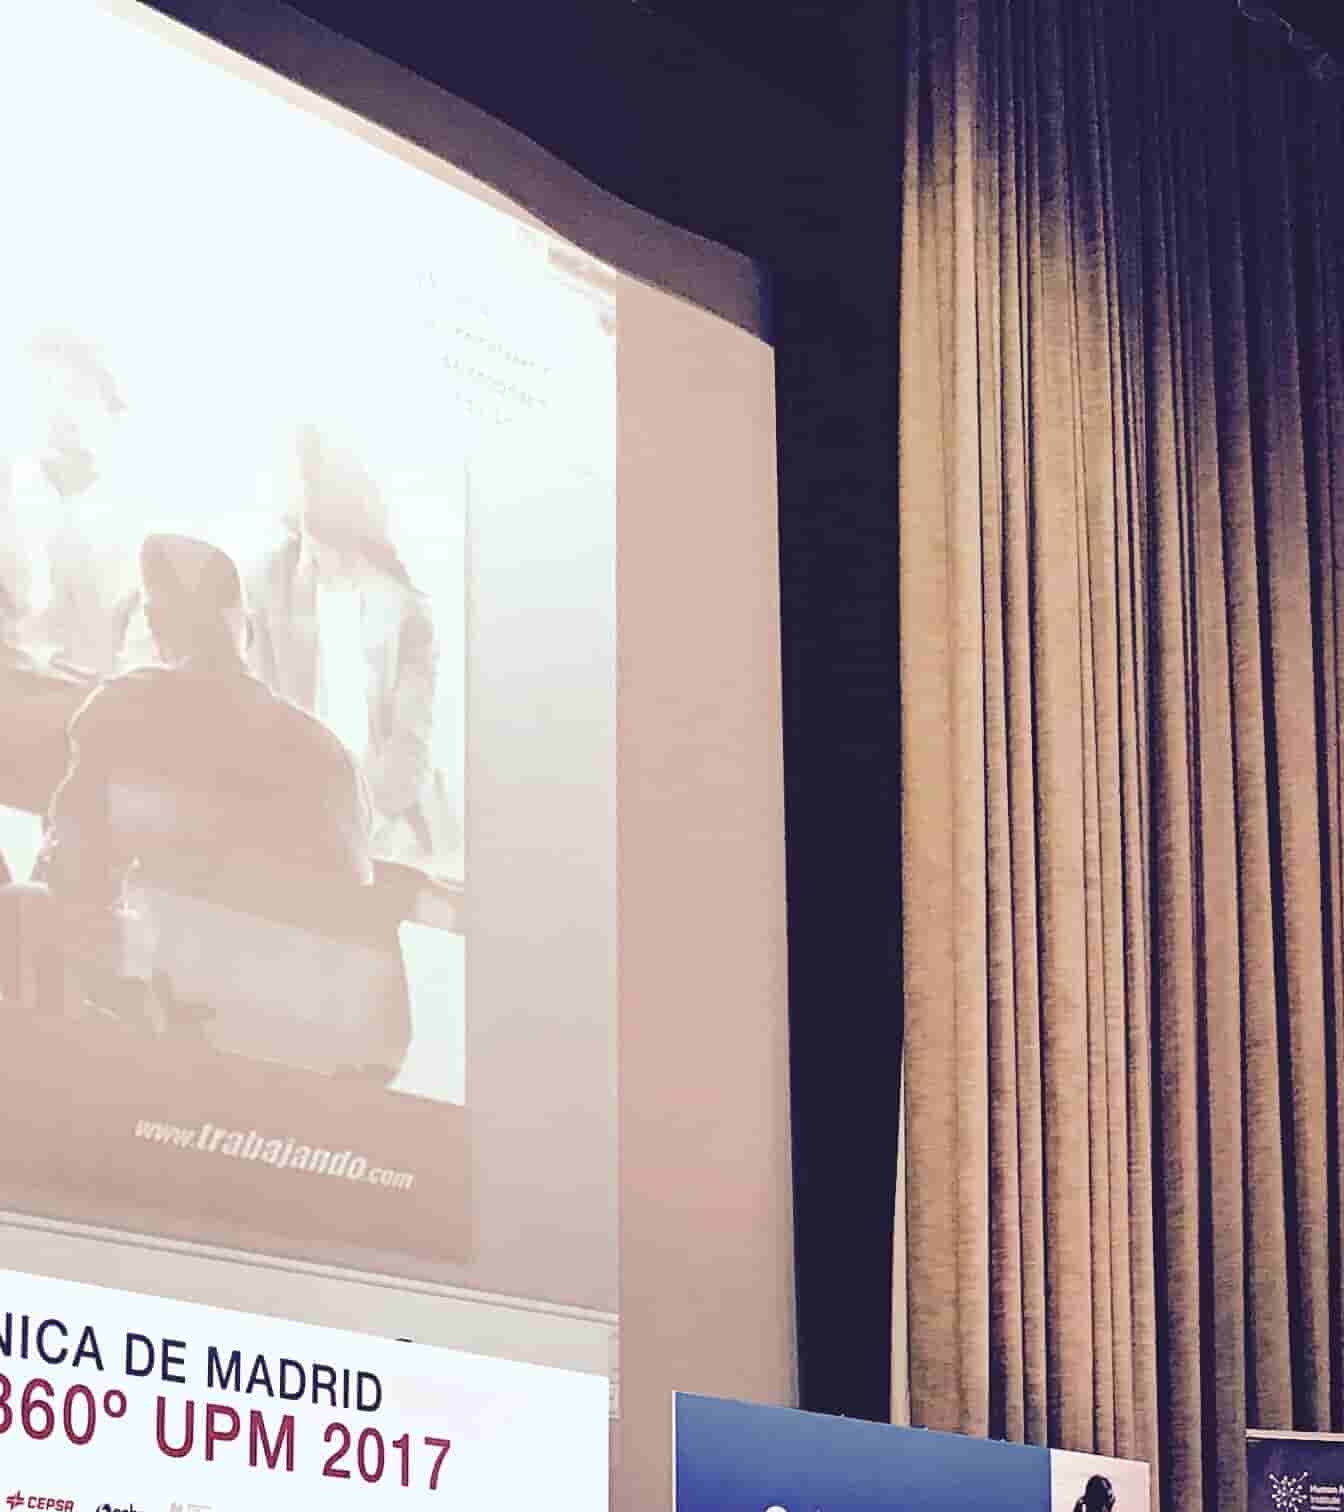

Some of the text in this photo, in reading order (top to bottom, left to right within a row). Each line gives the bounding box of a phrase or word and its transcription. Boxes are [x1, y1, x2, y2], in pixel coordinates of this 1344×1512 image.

[134, 1114, 415, 1191] www.trabajando.com
[124, 1332, 187, 1384] DE
[206, 1346, 383, 1412] MADRID
[155, 1396, 296, 1473] UPM
[321, 1421, 453, 1492] 2017
